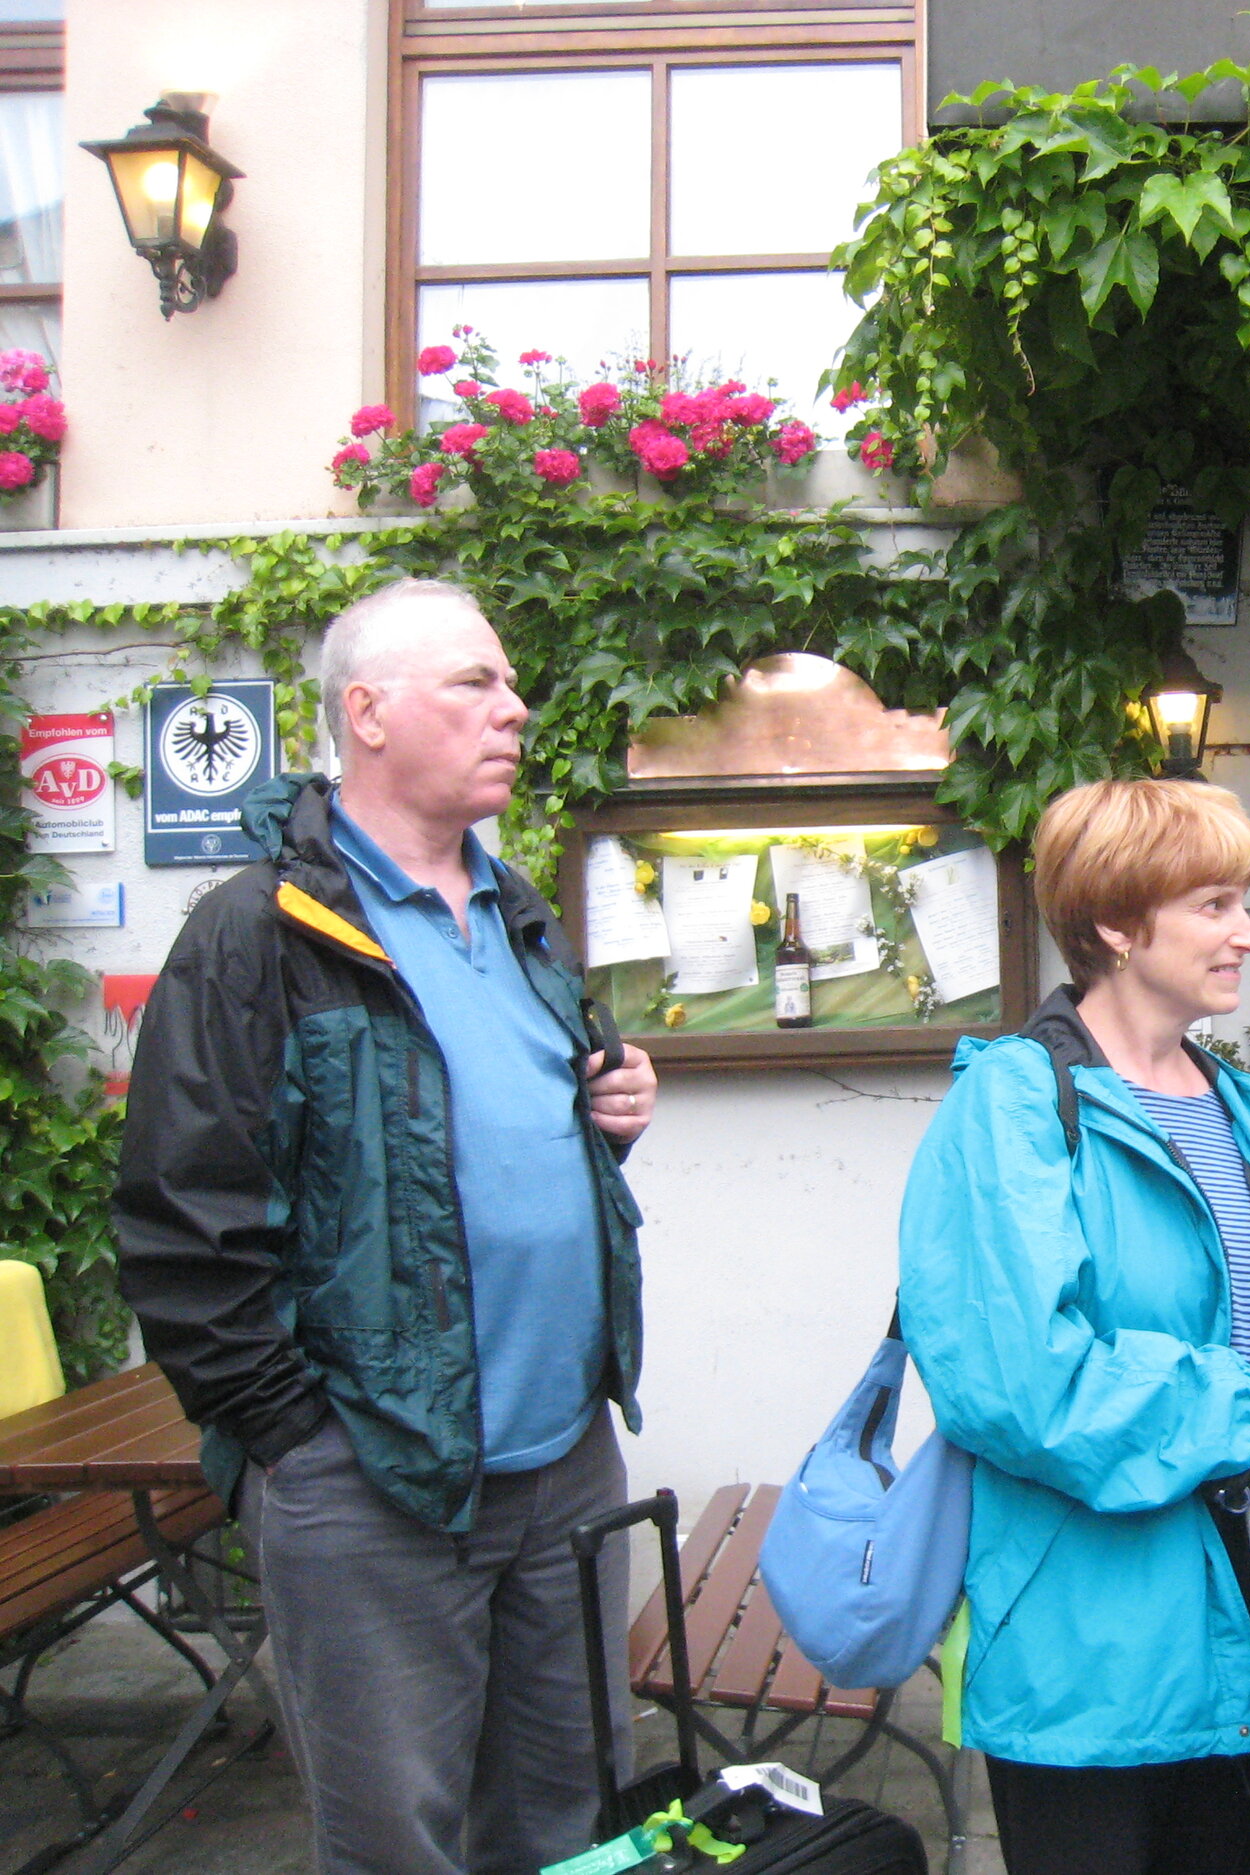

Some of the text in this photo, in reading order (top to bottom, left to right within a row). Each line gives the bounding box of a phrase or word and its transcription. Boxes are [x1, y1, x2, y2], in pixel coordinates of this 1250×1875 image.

[28, 727, 108, 739] Empfohlen vom
[155, 813, 178, 823] vom
[179, 808, 210, 823] ADAC
[35, 819, 104, 829] Automobilclub
[52, 830, 104, 839] Deutschland
